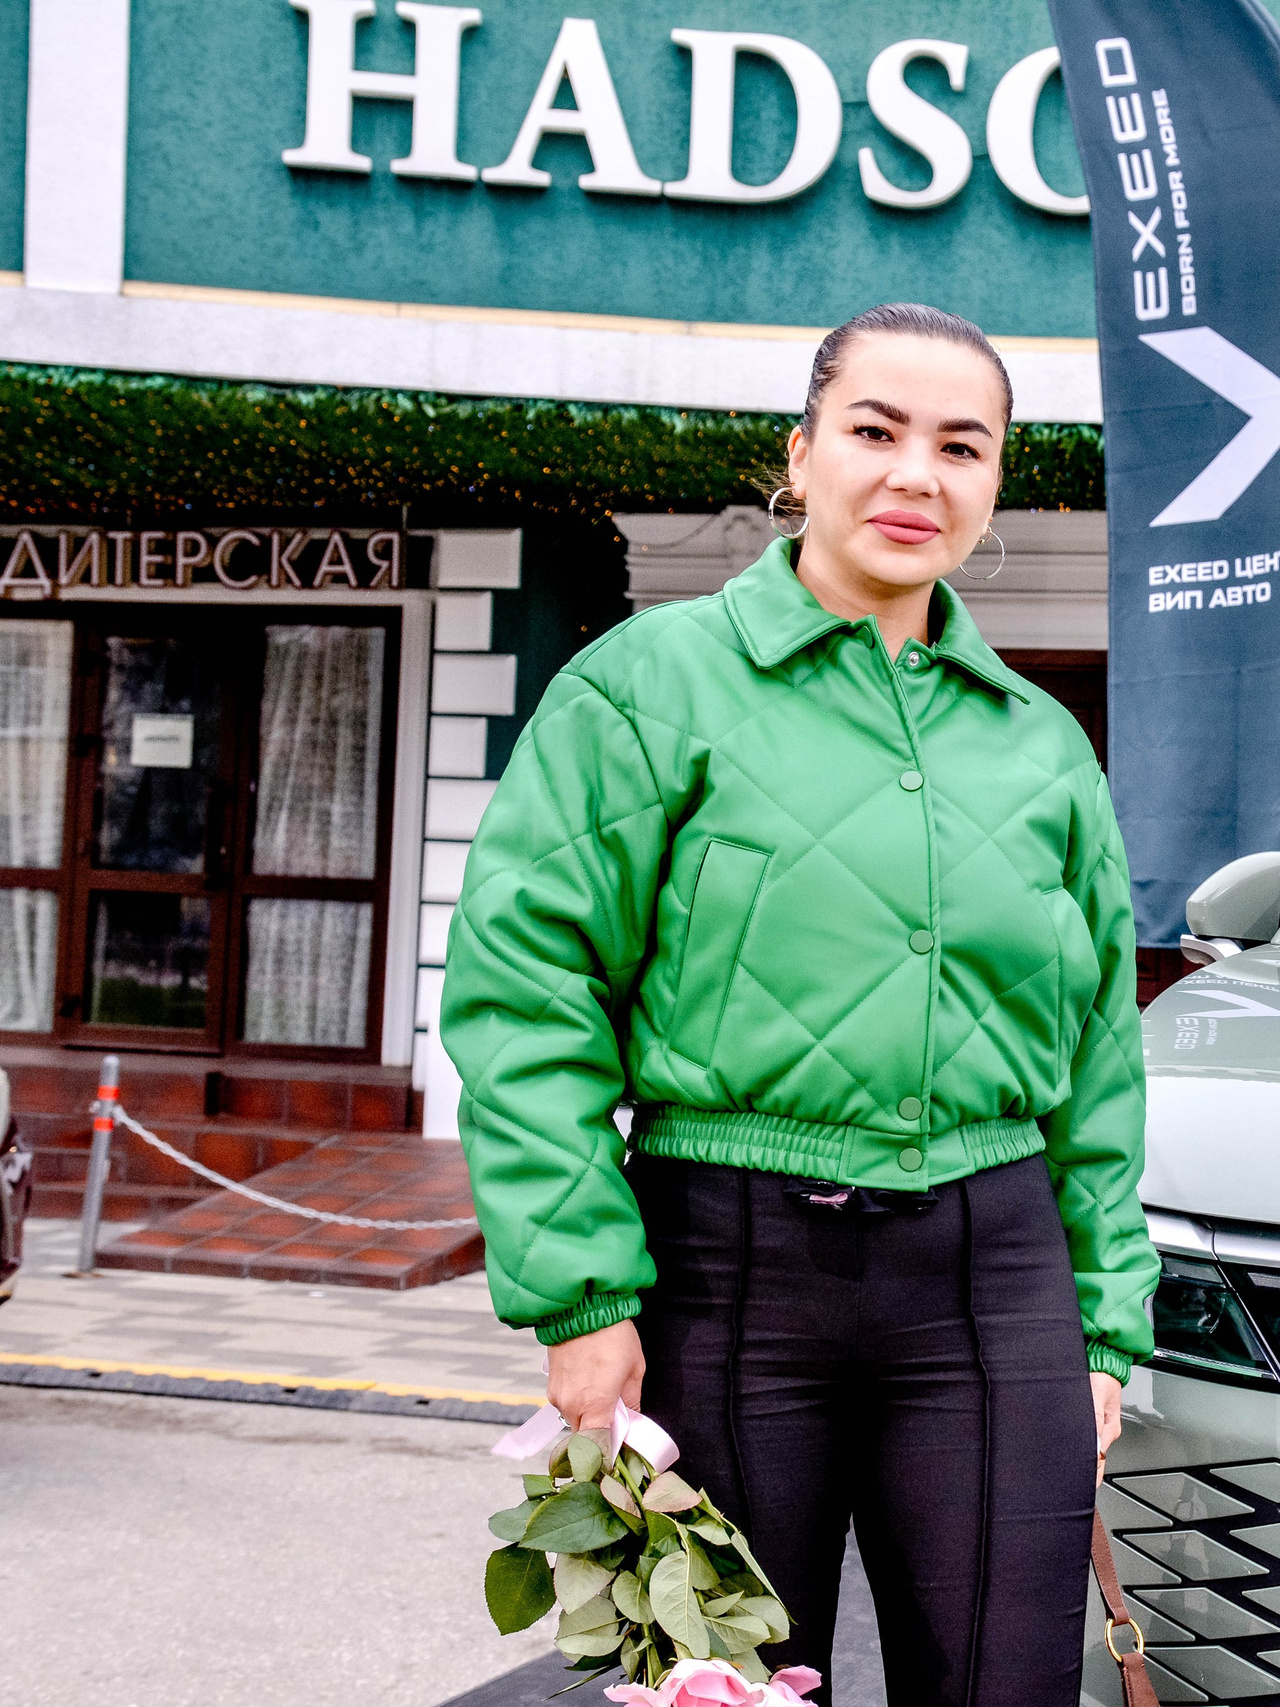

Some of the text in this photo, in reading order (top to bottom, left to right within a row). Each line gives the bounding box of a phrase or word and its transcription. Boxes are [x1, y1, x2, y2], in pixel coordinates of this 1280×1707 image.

[1095, 37, 1170, 322] EXEED
[1151, 88, 1197, 316] BORN FOR MORE
[0, 530, 401, 597] ДИТЕРСКАЯ
[1149, 559, 1229, 586] EXEED
[1149, 582, 1271, 613] ВИП АВТО
